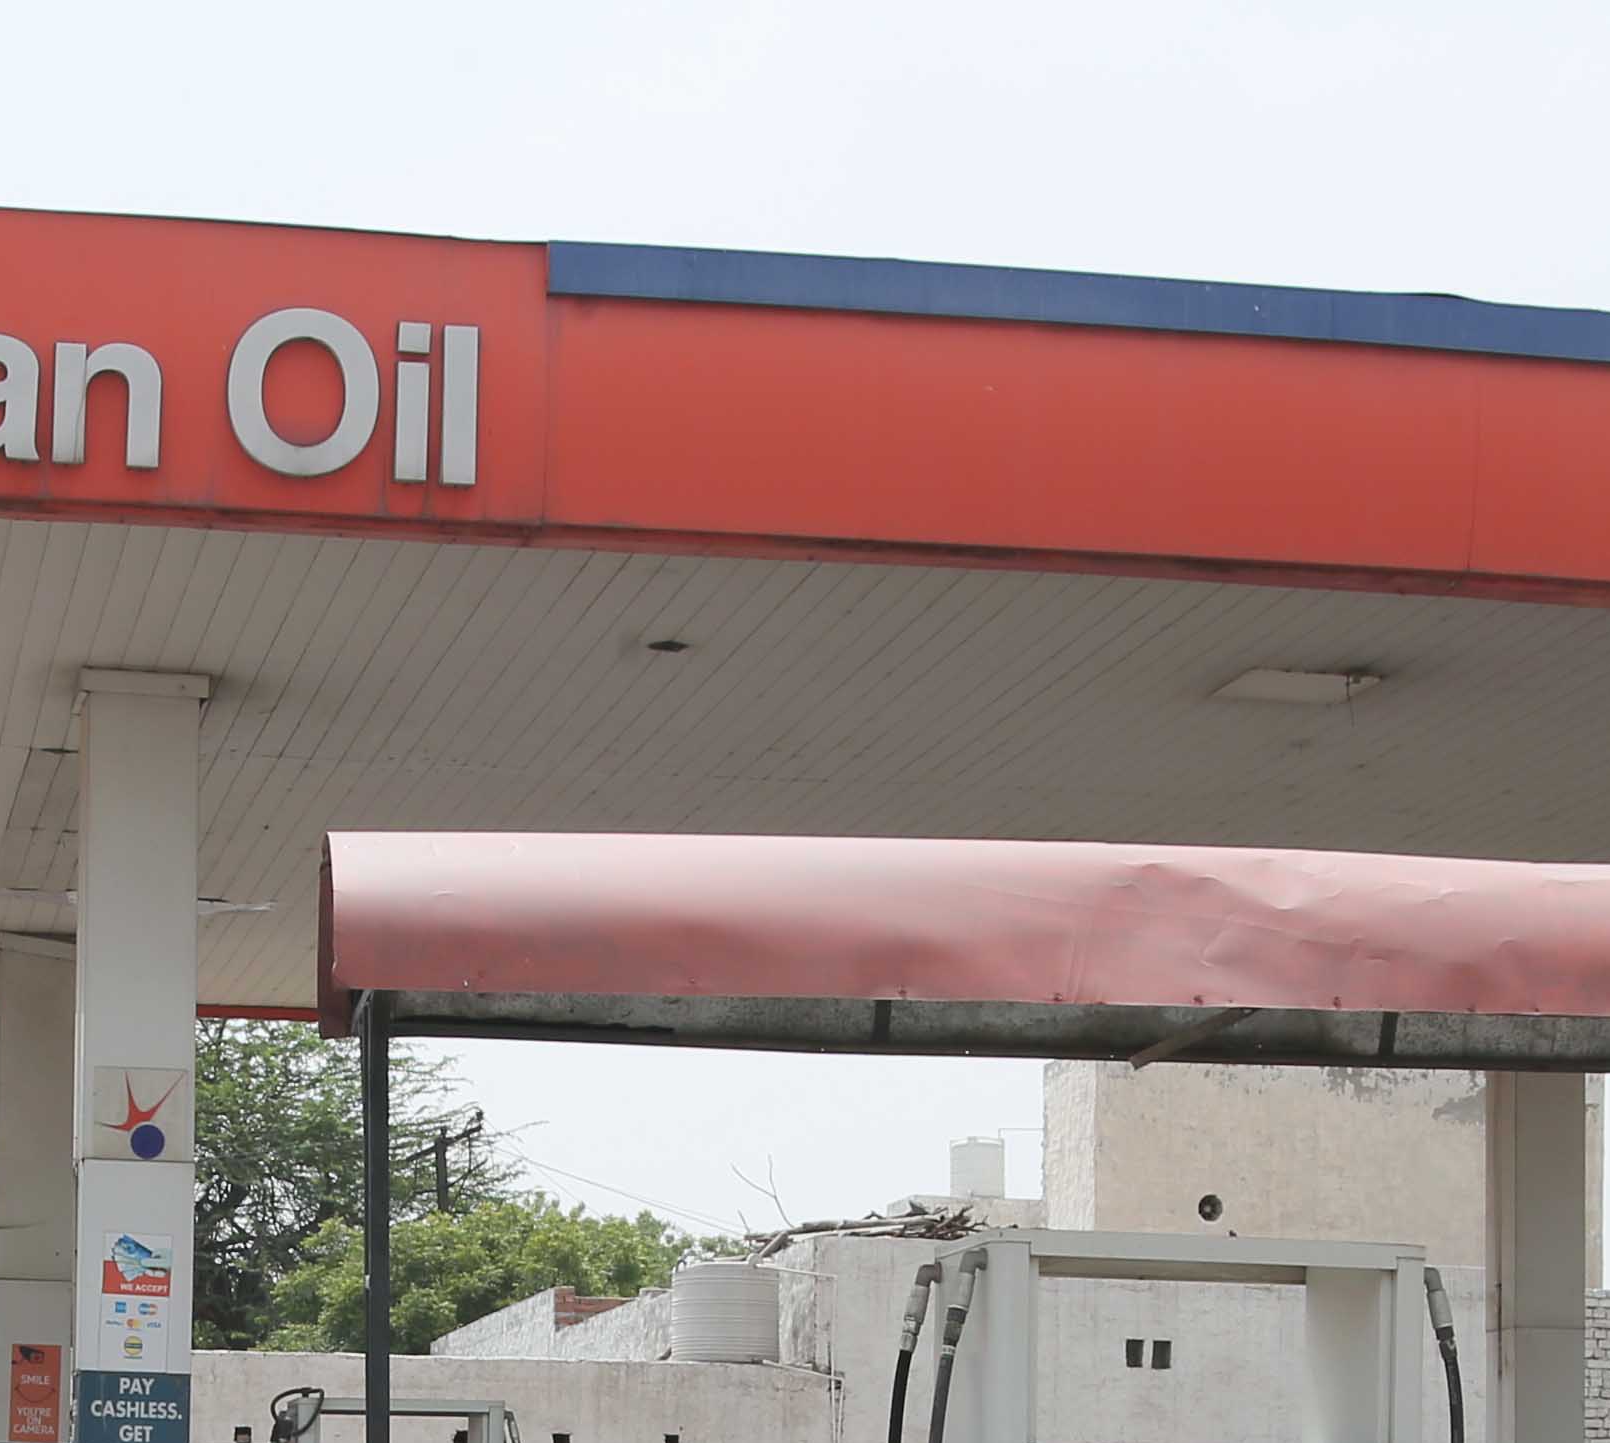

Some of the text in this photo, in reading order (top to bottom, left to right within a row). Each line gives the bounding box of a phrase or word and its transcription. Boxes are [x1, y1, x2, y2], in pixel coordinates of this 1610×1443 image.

[226, 306, 481, 488] Oil
[119, 1283, 168, 1293] WE ACCEPT
[20, 1375, 50, 1385] SMILE
[119, 1377, 155, 1395] PAY
[91, 1400, 182, 1420] CASHLESS.
[26, 1416, 42, 1425] ON
[13, 1424, 54, 1434] CAMERA
[119, 1425, 153, 1442] GET
